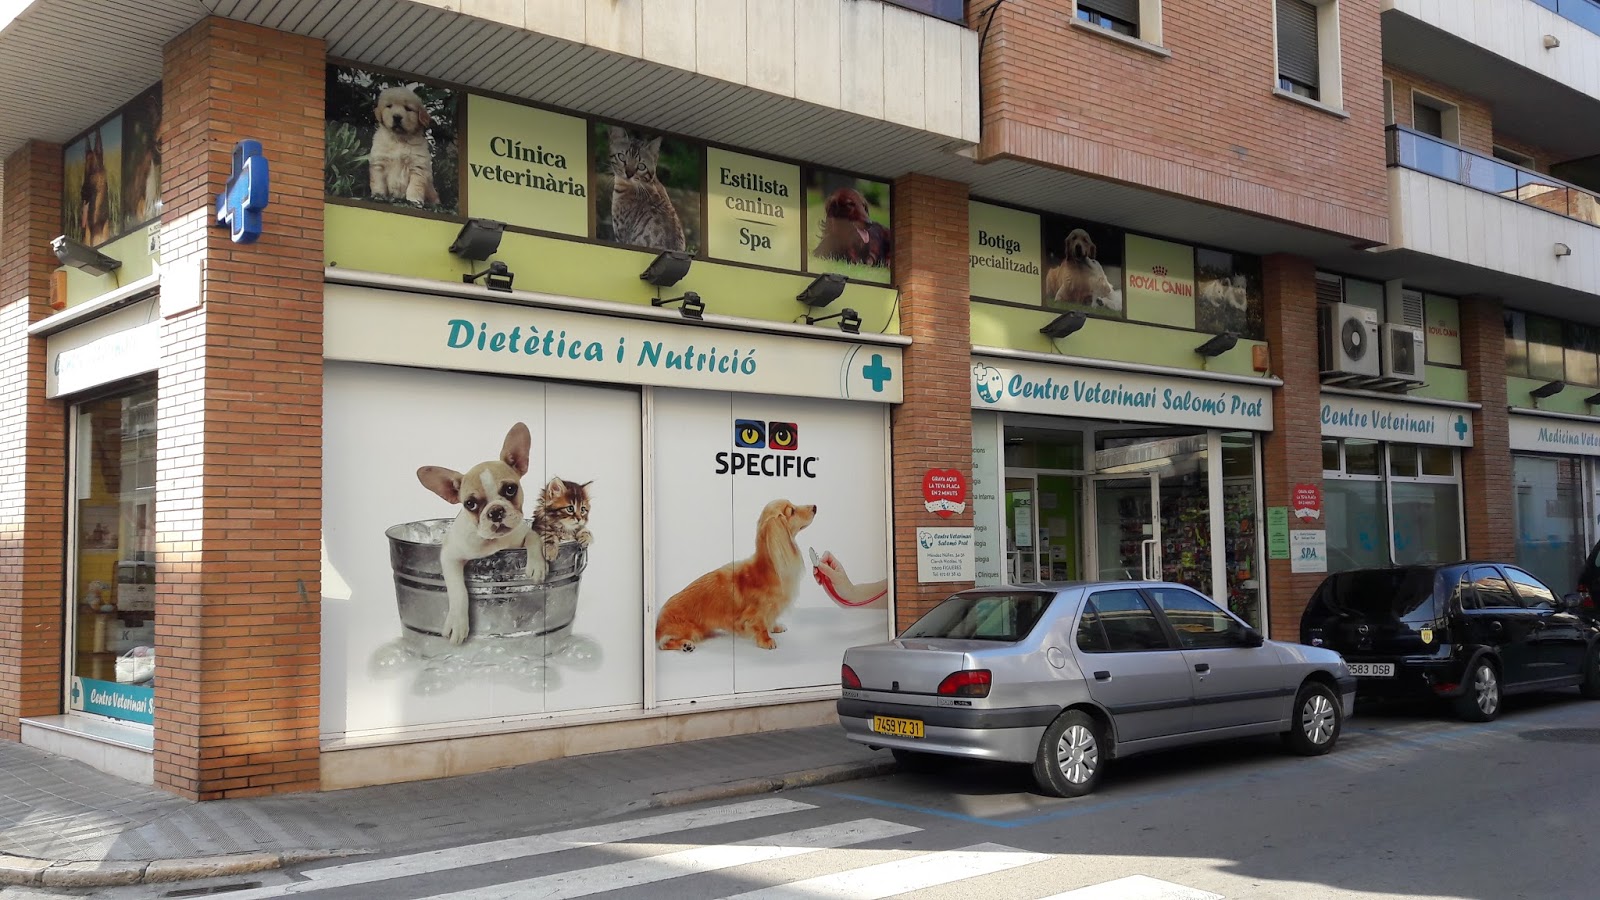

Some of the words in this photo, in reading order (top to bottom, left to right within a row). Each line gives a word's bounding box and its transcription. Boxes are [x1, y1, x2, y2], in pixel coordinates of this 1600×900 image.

[490, 136, 567, 169] Clínica
[469, 163, 586, 197] veterinària
[720, 167, 788, 197] Estilista
[725, 196, 784, 218] canina
[739, 227, 771, 251] Spa
[978, 230, 1021, 255] Botiga
[1130, 274, 1159, 291] ROYAL
[1162, 281, 1191, 297] CANIN
[447, 319, 604, 362] Dietètica
[616, 337, 625, 363] i
[637, 340, 757, 375] Nutrició
[1008, 374, 1069, 400] Centre
[1074, 380, 1156, 408] Veterinari
[1163, 388, 1225, 415] Salomó
[1231, 395, 1262, 417] Prat
[1321, 404, 1367, 427] Centre
[1372, 409, 1434, 434] Veterinari
[1538, 427, 1579, 445] Medicina
[1582, 432, 1600, 447] Vete
[715, 451, 817, 479] SPECIFIC
[1301, 547, 1317, 559] SPA
[1373, 664, 1390, 675] DSB
[91, 688, 112, 707] Centre
[113, 692, 147, 713] Veterinari
[148, 698, 156, 715] S
[877, 717, 896, 733] 7459
[897, 720, 907, 734] YZ
[909, 721, 919, 735] 31
